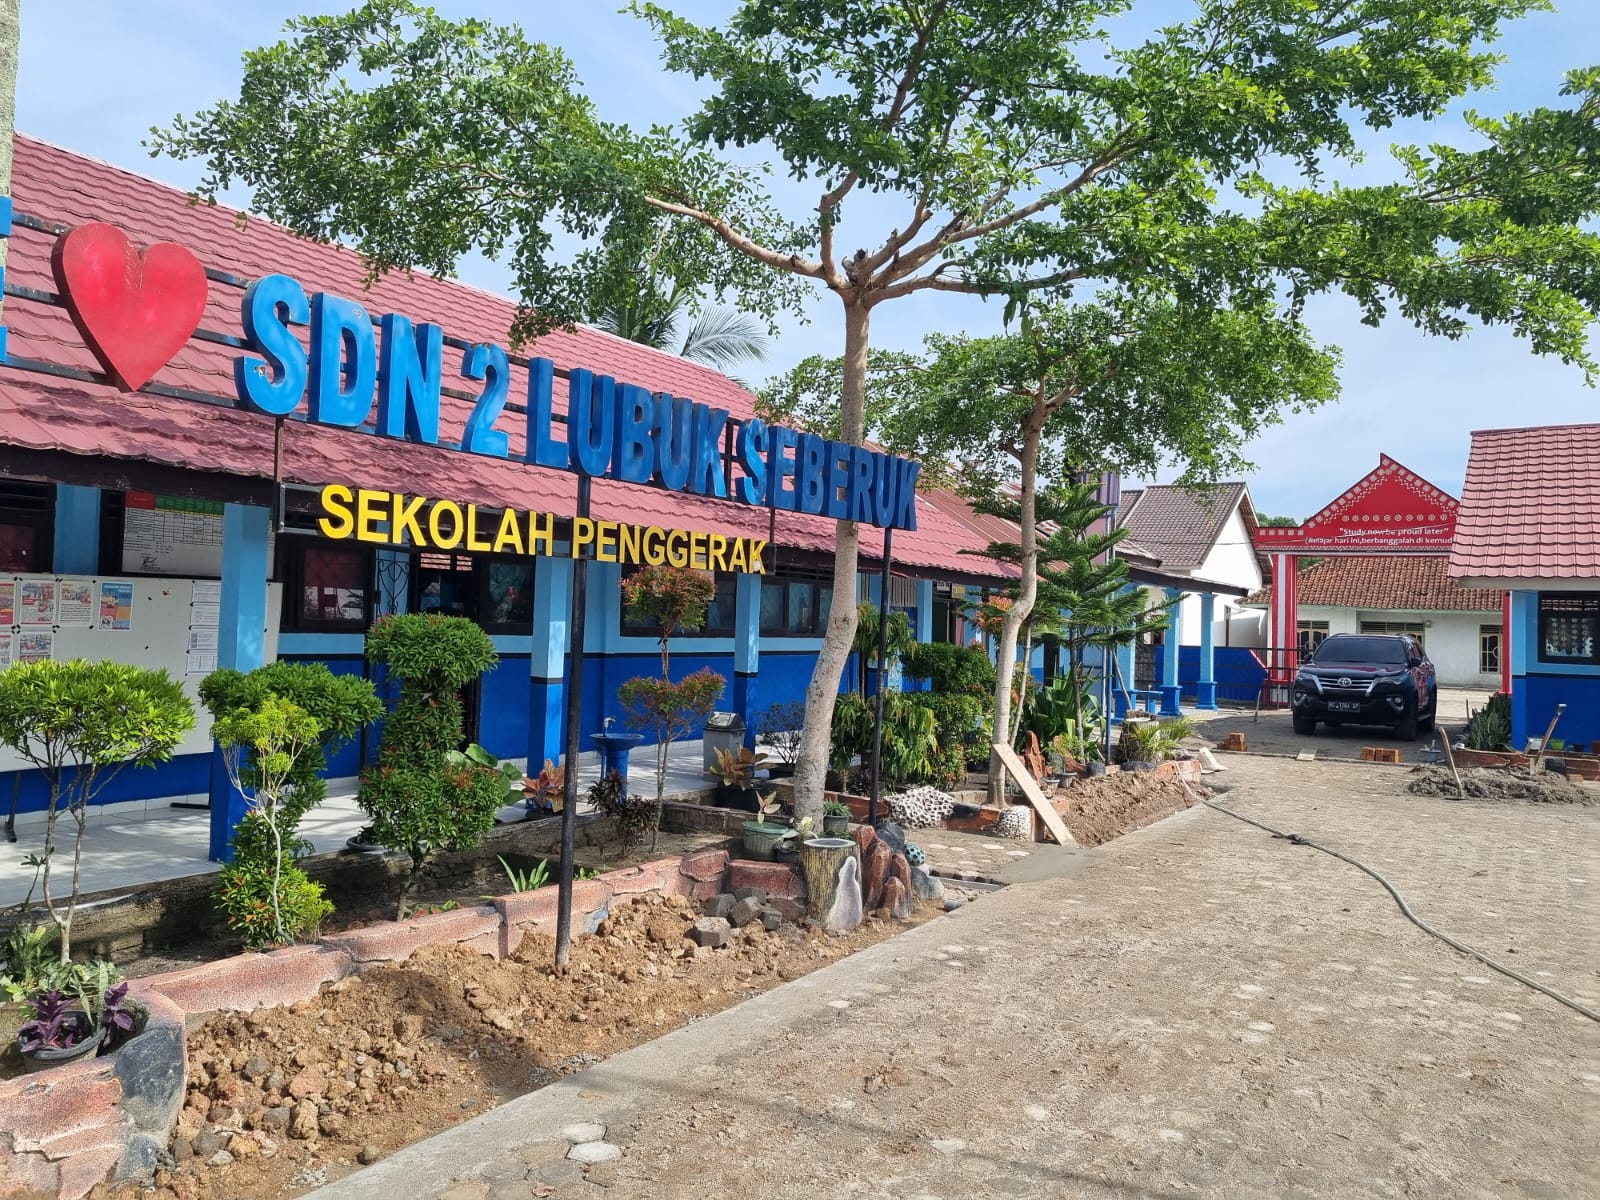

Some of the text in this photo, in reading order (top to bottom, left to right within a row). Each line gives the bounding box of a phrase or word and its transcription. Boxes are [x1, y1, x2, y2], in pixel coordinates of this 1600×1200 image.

[233, 273, 920, 531] SDN 2 LUBUK SEBERUK
[316, 484, 766, 574] SEKOLAH PENGGERAK
[1398, 528, 1422, 536] proud
